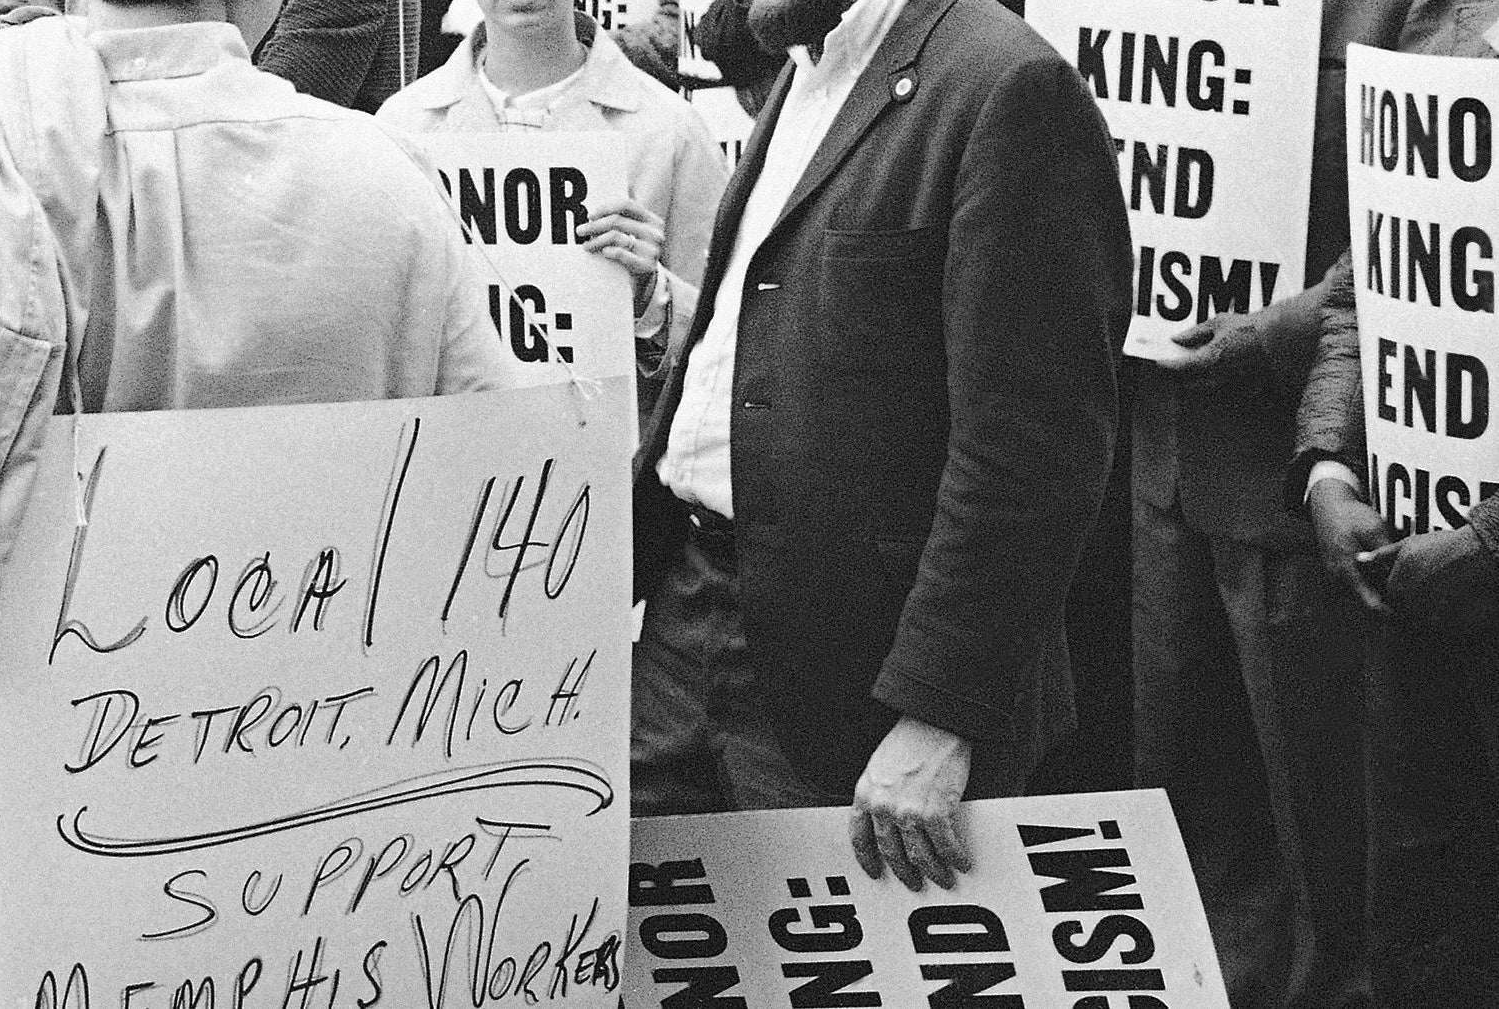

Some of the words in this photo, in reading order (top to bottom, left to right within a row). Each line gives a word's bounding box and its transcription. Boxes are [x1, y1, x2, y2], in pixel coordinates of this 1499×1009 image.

[1076, 26, 1252, 115] KING:
[438, 167, 591, 245] NOR
[1113, 138, 1214, 220] ND
[1367, 208, 1495, 314] KING
[1377, 336, 1491, 440] END
[441, 457, 592, 631] 140
[1016, 819, 1170, 1009] ISM!
